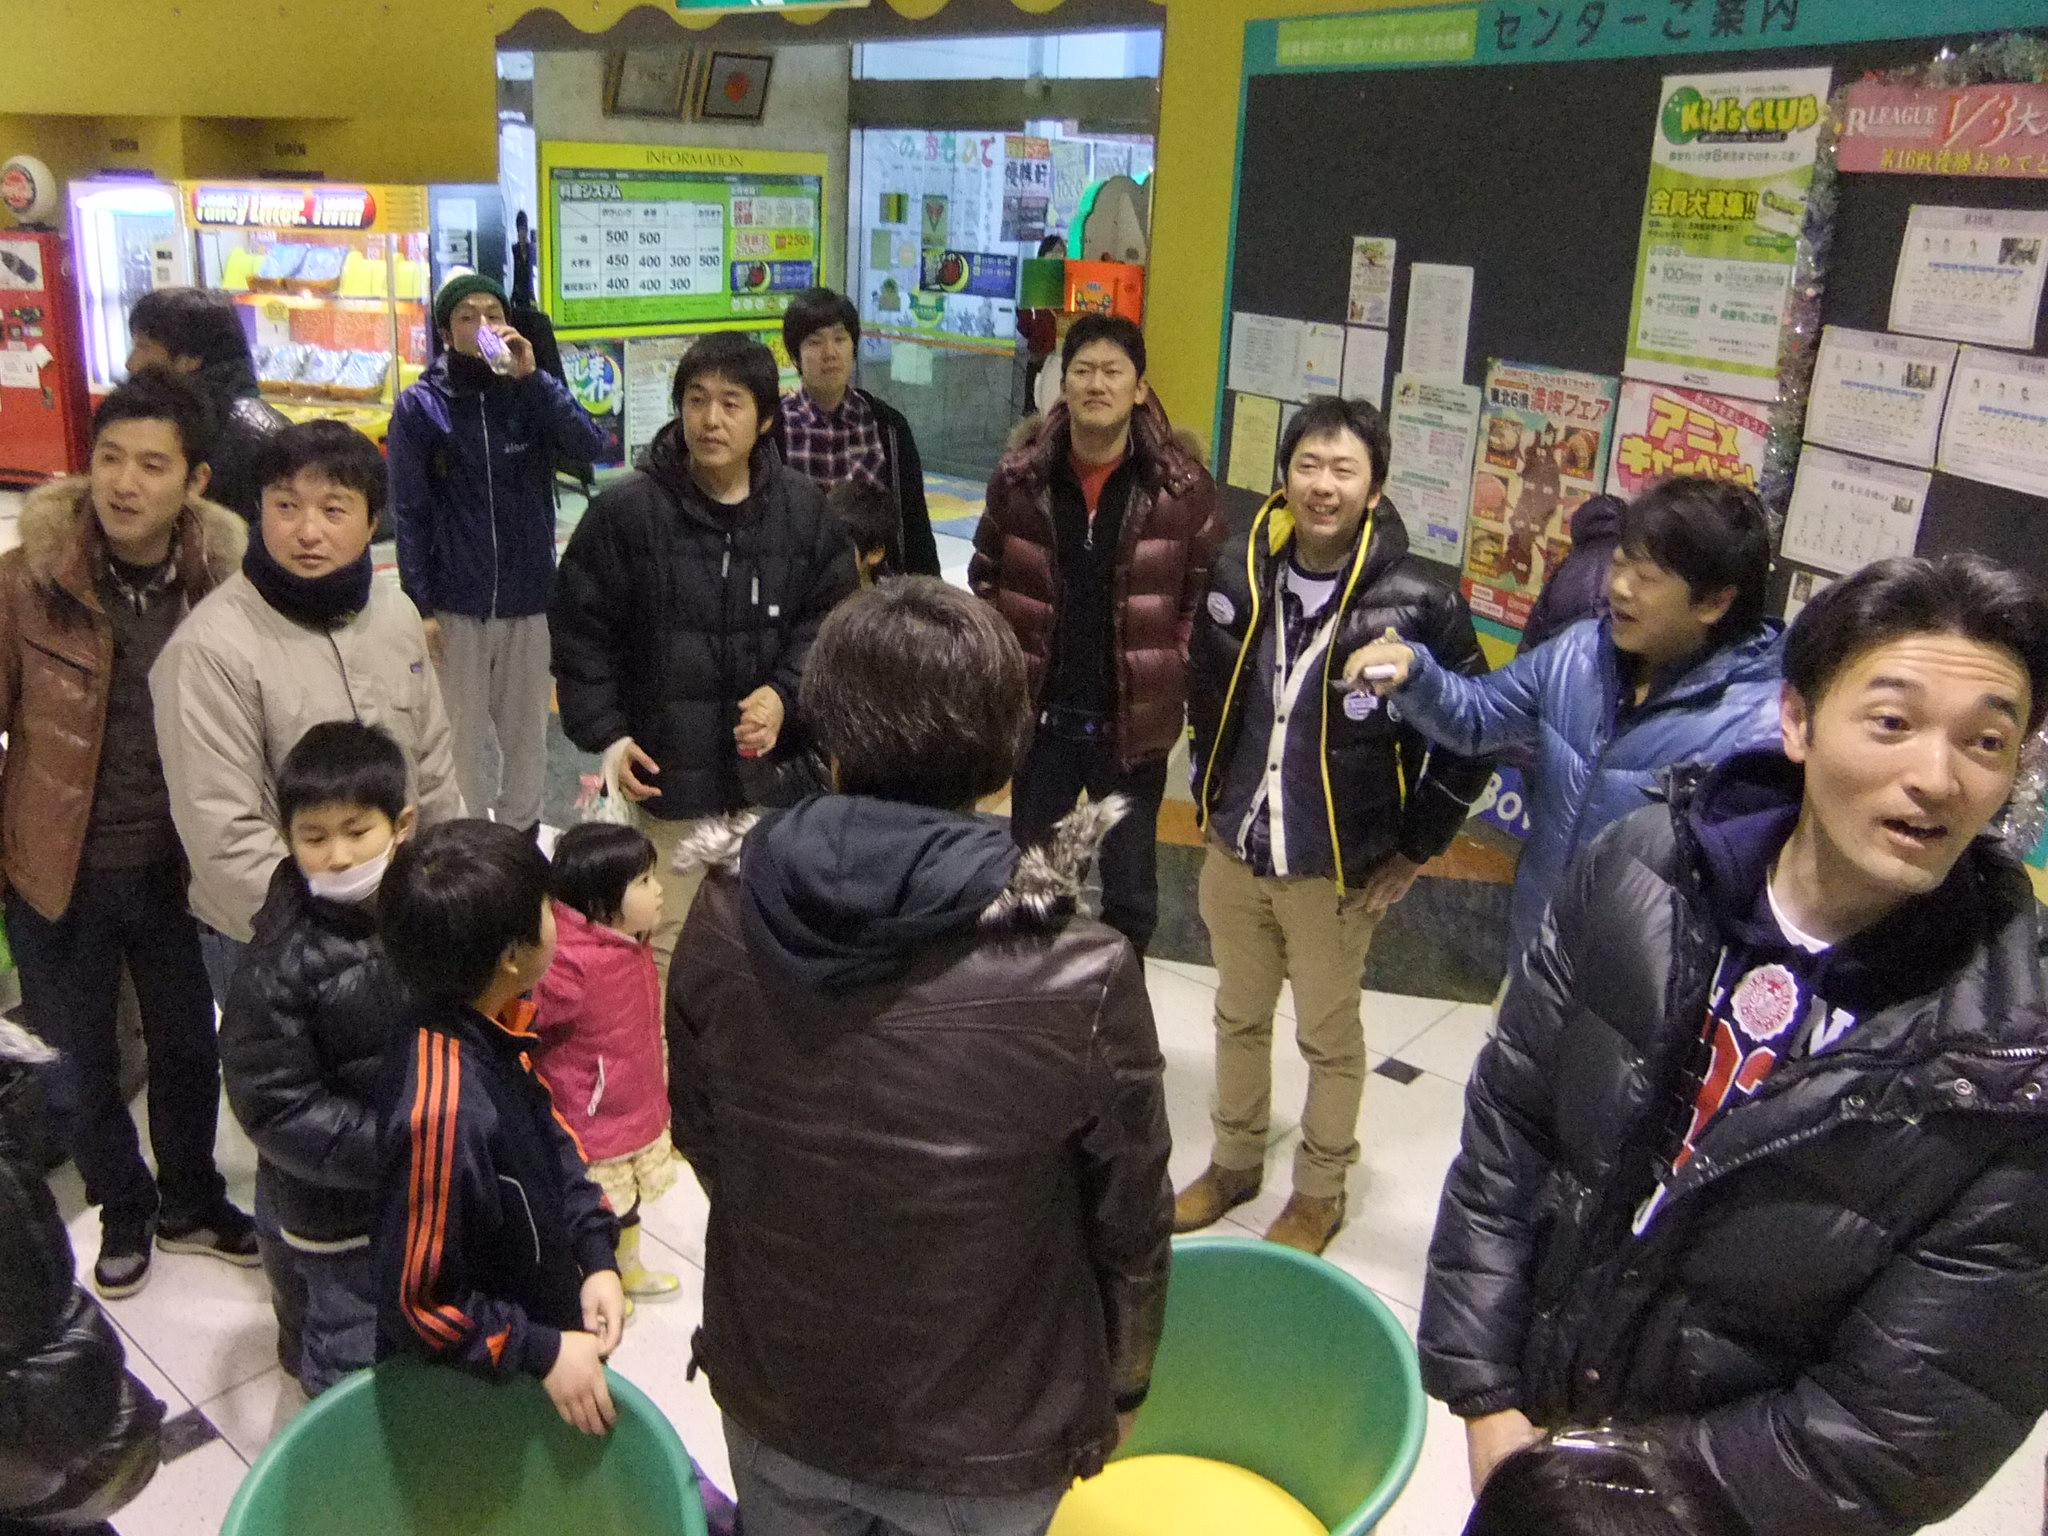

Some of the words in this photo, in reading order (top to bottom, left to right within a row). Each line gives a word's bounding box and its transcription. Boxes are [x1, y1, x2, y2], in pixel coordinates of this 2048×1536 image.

[1495, 0, 1798, 50] センターご案内
[1745, 94, 1818, 133] CLUB
[645, 151, 744, 168] INFORMATION
[606, 230, 629, 243] 500
[639, 232, 661, 244] 500
[606, 254, 629, 266] 450
[639, 256, 661, 268] 400
[669, 255, 691, 267] 300
[699, 255, 720, 267] 500
[606, 278, 629, 290] 400
[639, 279, 661, 290] 400
[669, 278, 691, 290] 300
[1650, 396, 1739, 456] アニメ
